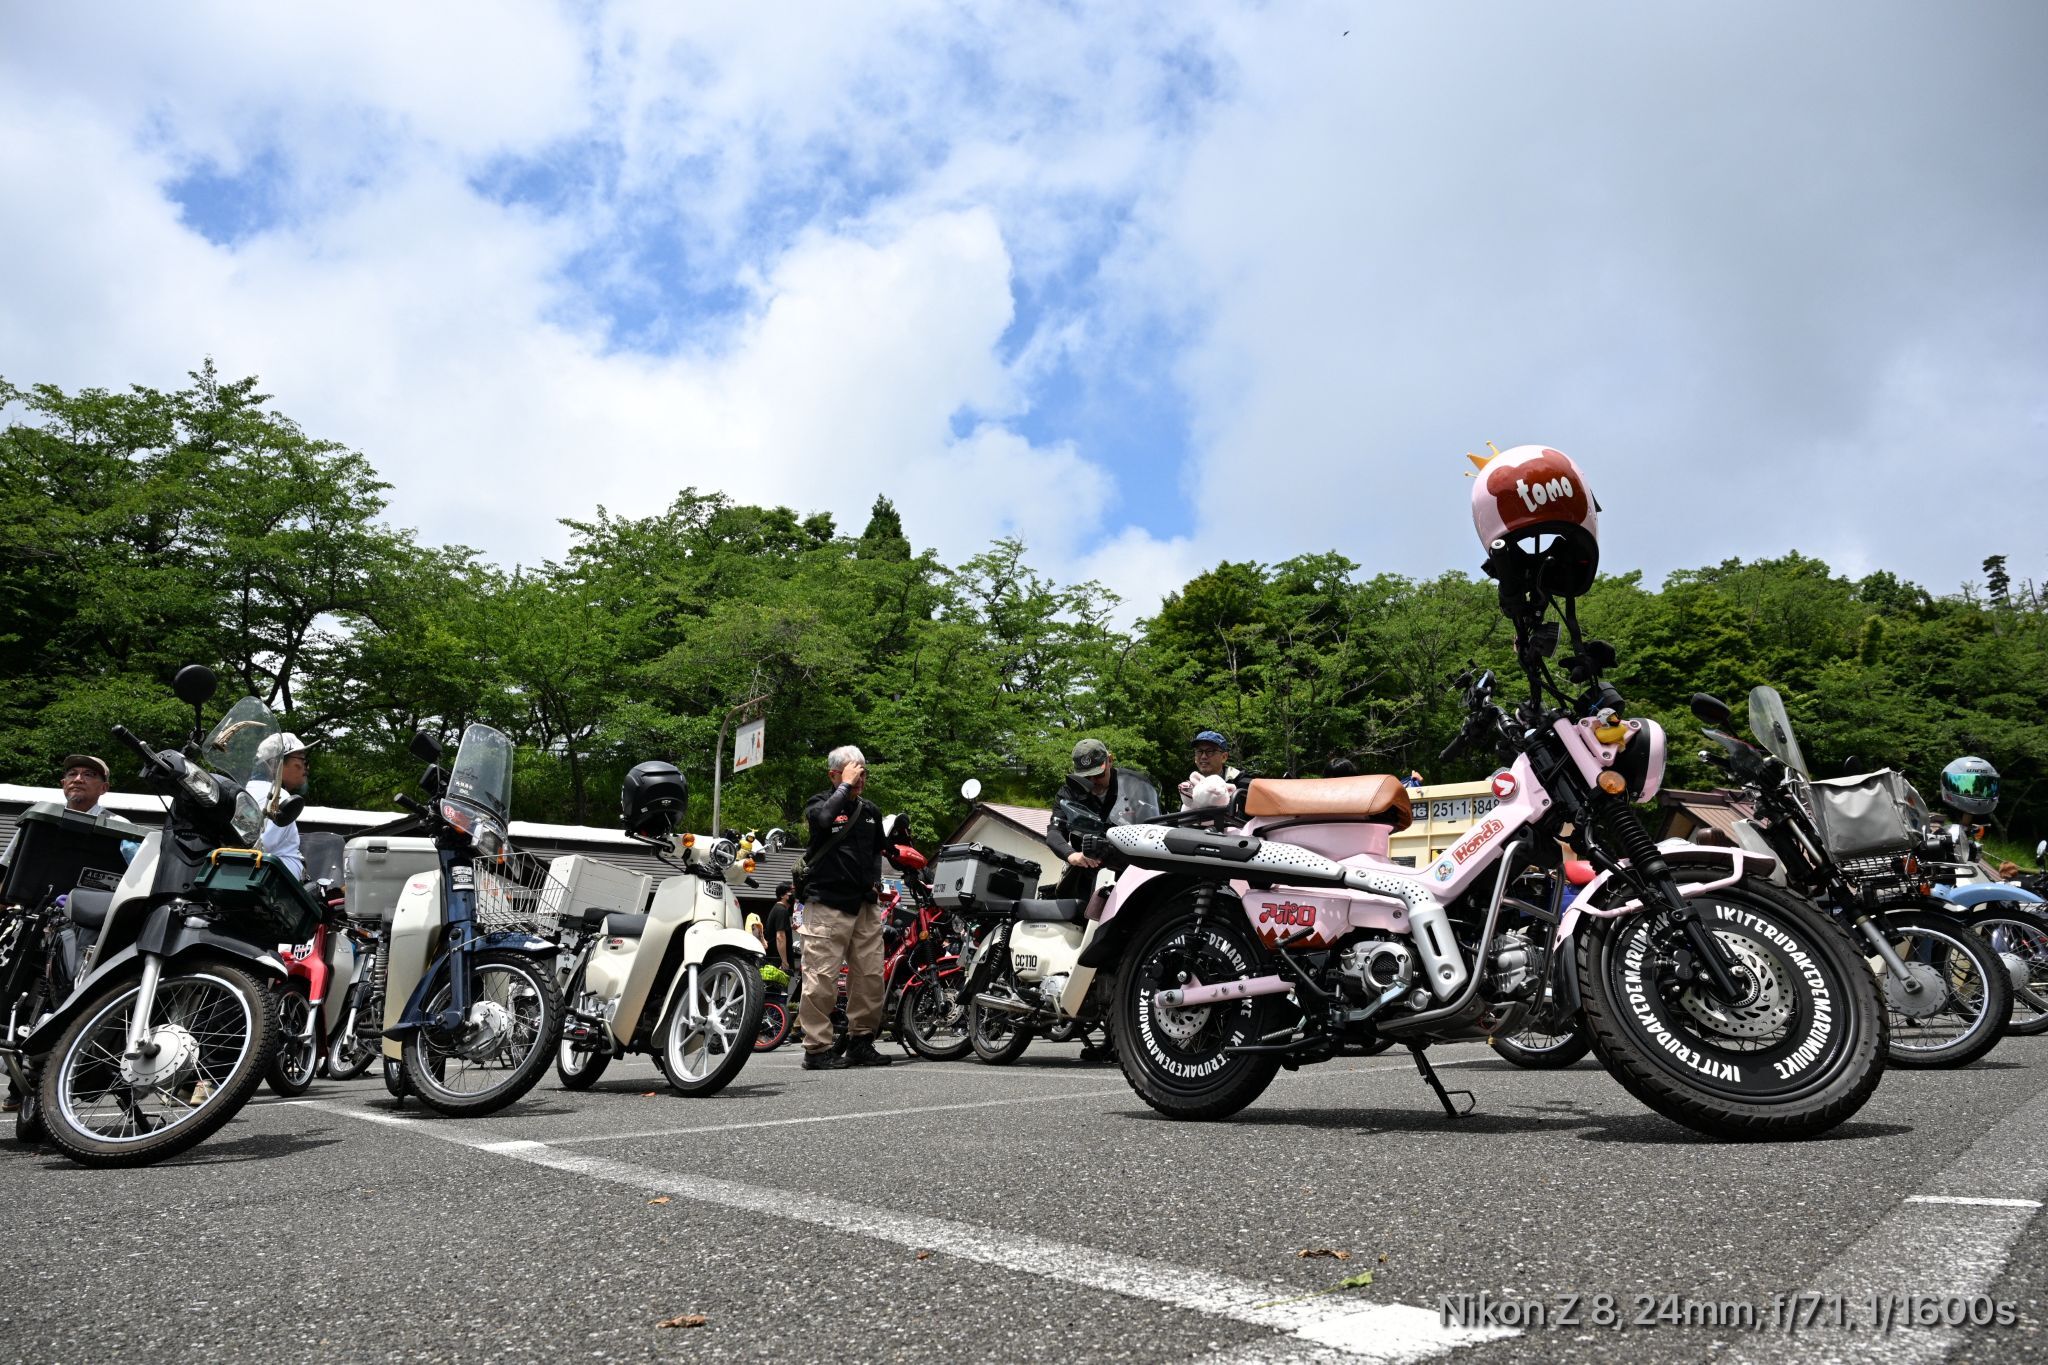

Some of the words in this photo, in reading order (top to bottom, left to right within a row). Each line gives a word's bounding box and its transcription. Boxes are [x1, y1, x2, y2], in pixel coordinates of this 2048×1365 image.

[1516, 476, 1574, 513] tomo
[1453, 820, 1504, 864] Honda
[1259, 901, 1317, 927] アポロ
[1015, 953, 1038, 968] CC110
[1715, 904, 1832, 1080] IKITERUDAKEDEMARUMOUKE
